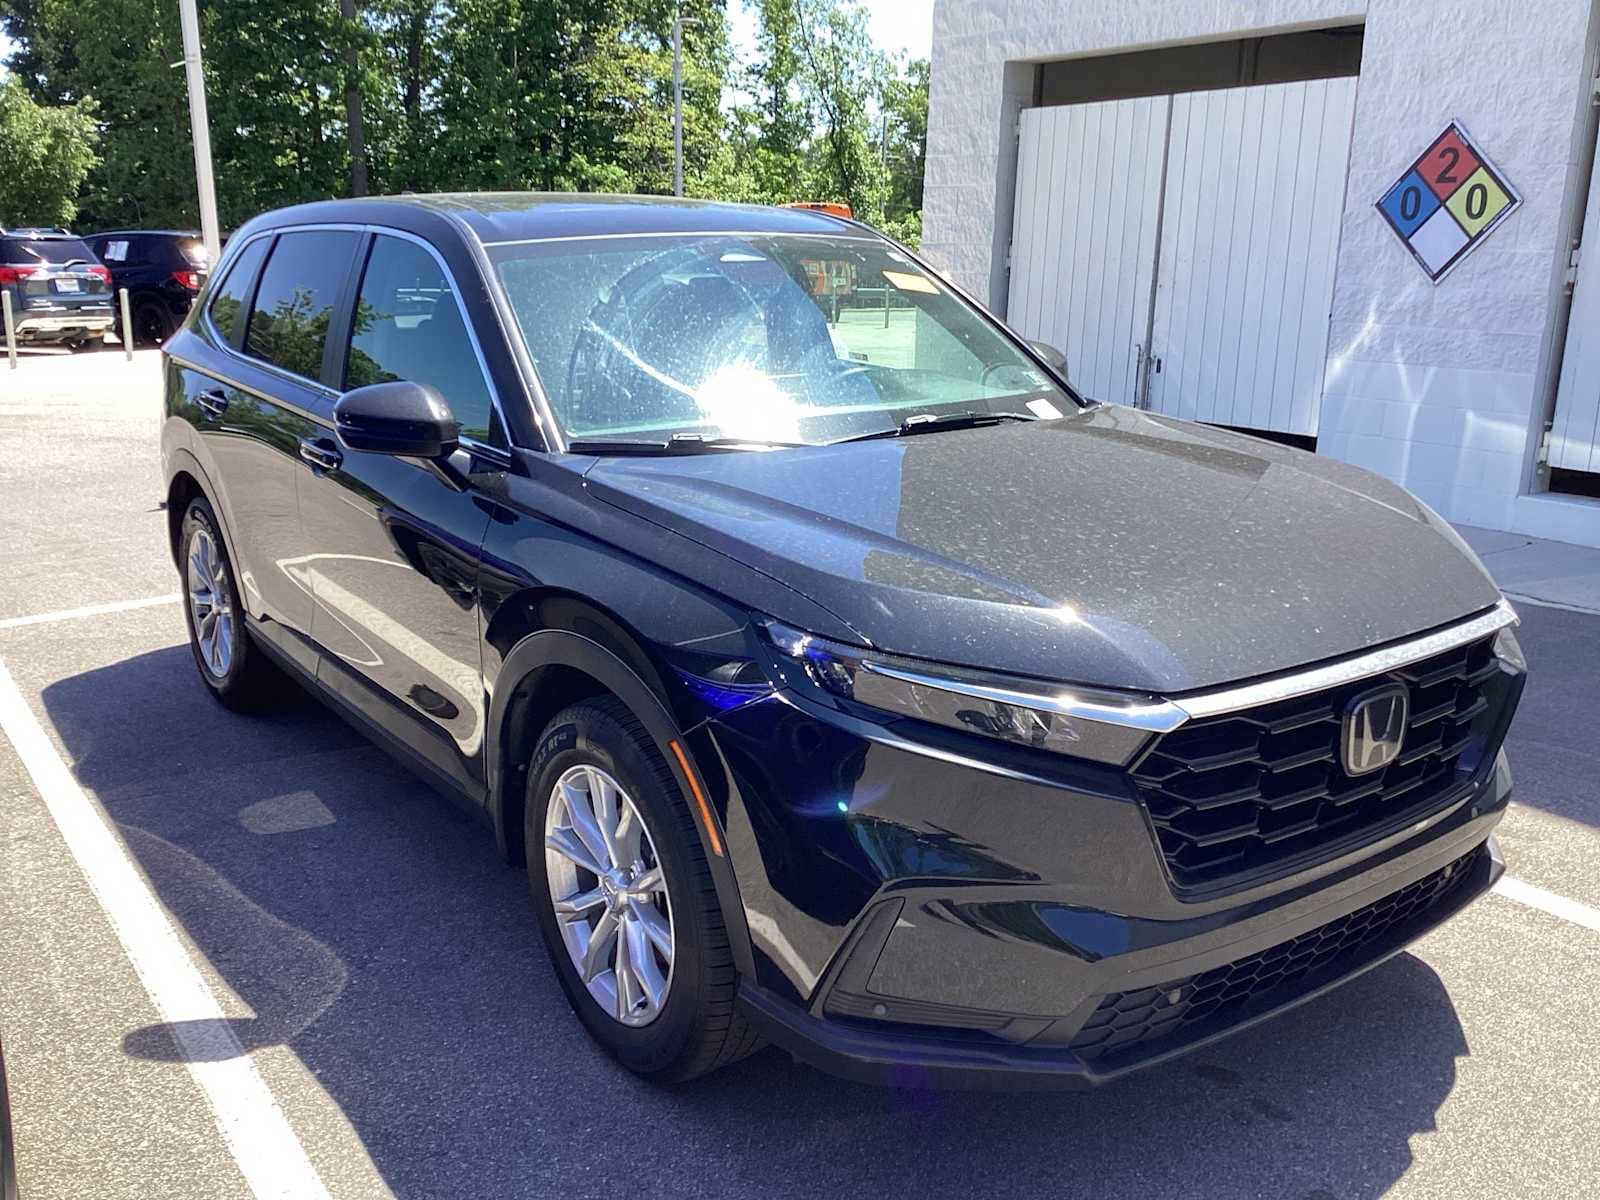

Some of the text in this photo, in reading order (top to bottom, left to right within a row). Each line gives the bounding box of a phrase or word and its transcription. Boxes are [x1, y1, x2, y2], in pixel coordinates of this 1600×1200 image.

[1435, 147, 1460, 184] 2
[1400, 185, 1422, 221] 0
[1465, 183, 1488, 220] 0
